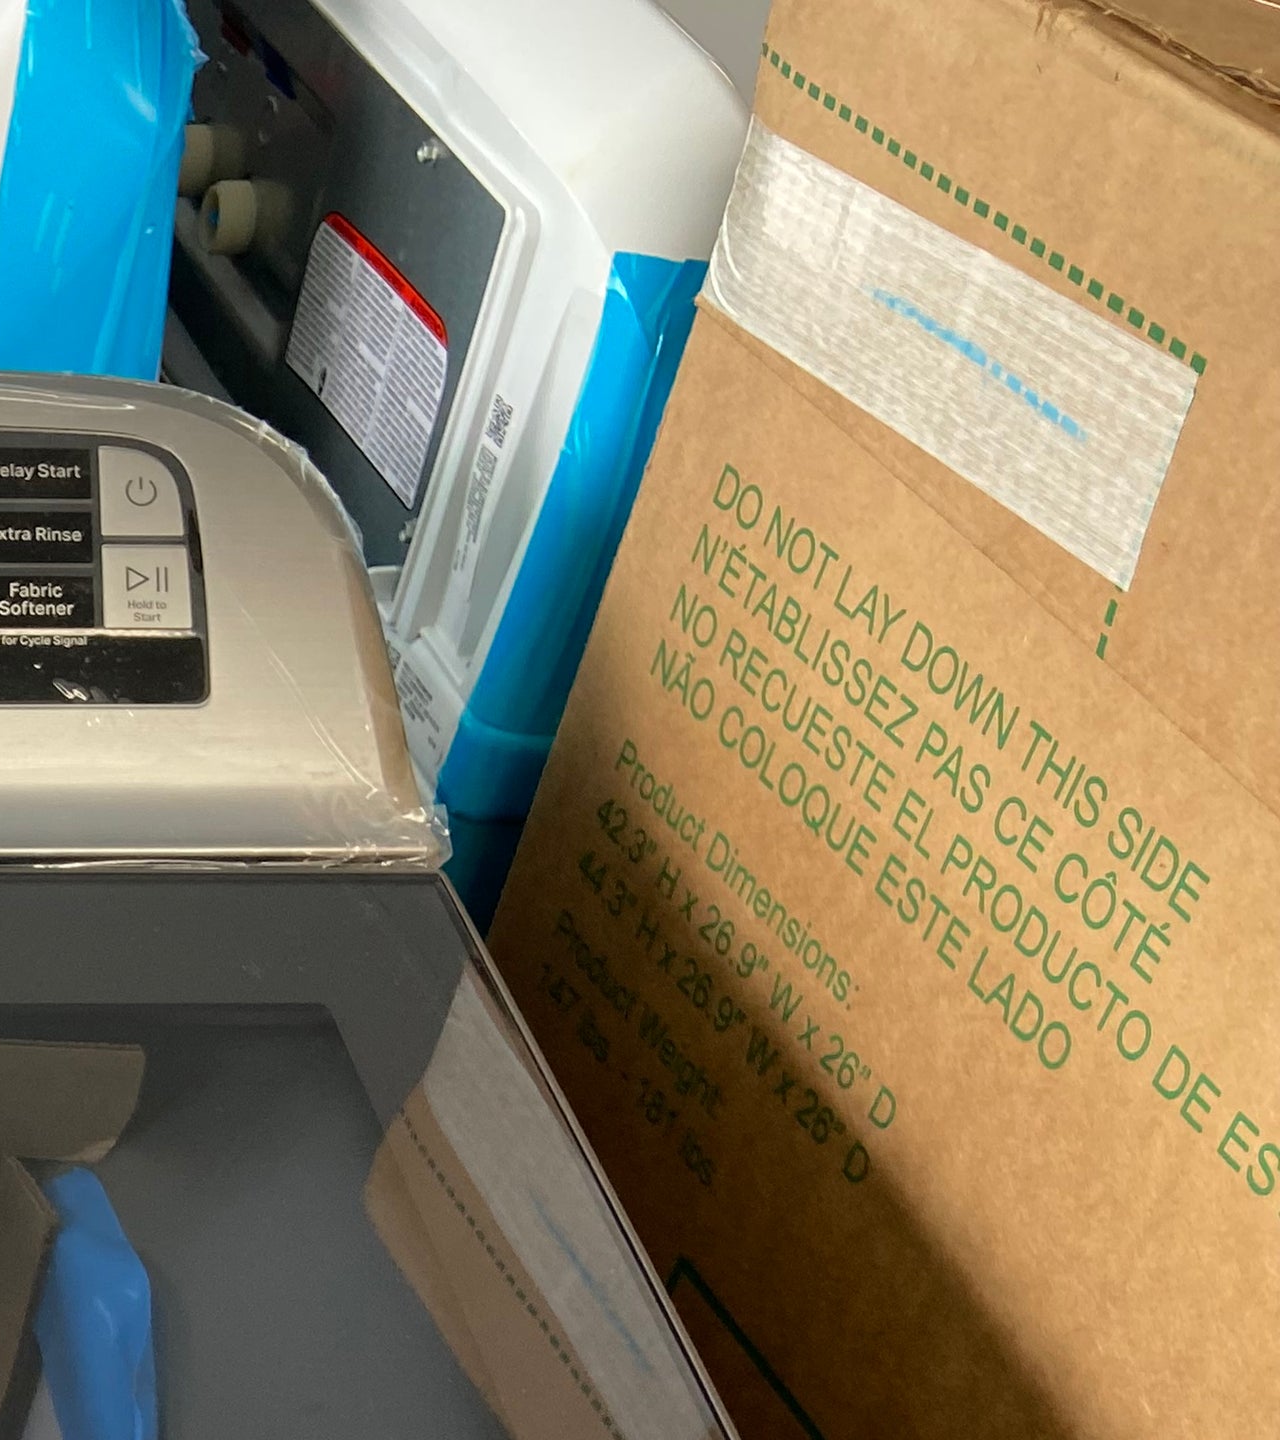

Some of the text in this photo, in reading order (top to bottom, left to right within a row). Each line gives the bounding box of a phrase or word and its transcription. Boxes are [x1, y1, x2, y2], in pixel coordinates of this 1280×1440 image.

[38, 463, 81, 478] Start
[35, 527, 82, 542] Rinse
[10, 582, 63, 598] Fabric
[127, 600, 167, 609] Hold to
[133, 612, 161, 622] Start
[1, 635, 17, 646] for
[20, 635, 49, 649] Cycle
[53, 635, 89, 649] Signal
[712, 462, 1211, 923] DO NOT LAY DOWN THIS SIDE
[691, 523, 1173, 984] N'ÉTABLISSEZ PAS CE CÔTÉ
[650, 640, 1073, 1071] NÃO COLOQUE ESTE LADO
[670, 584, 718, 649] NO
[719, 628, 896, 807] RECUESTE
[893, 787, 933, 859] EL
[940, 835, 1153, 1062] PRODUCTO
[1152, 1044, 1222, 1133] DE
[614, 739, 861, 1011] Product Dimensions:
